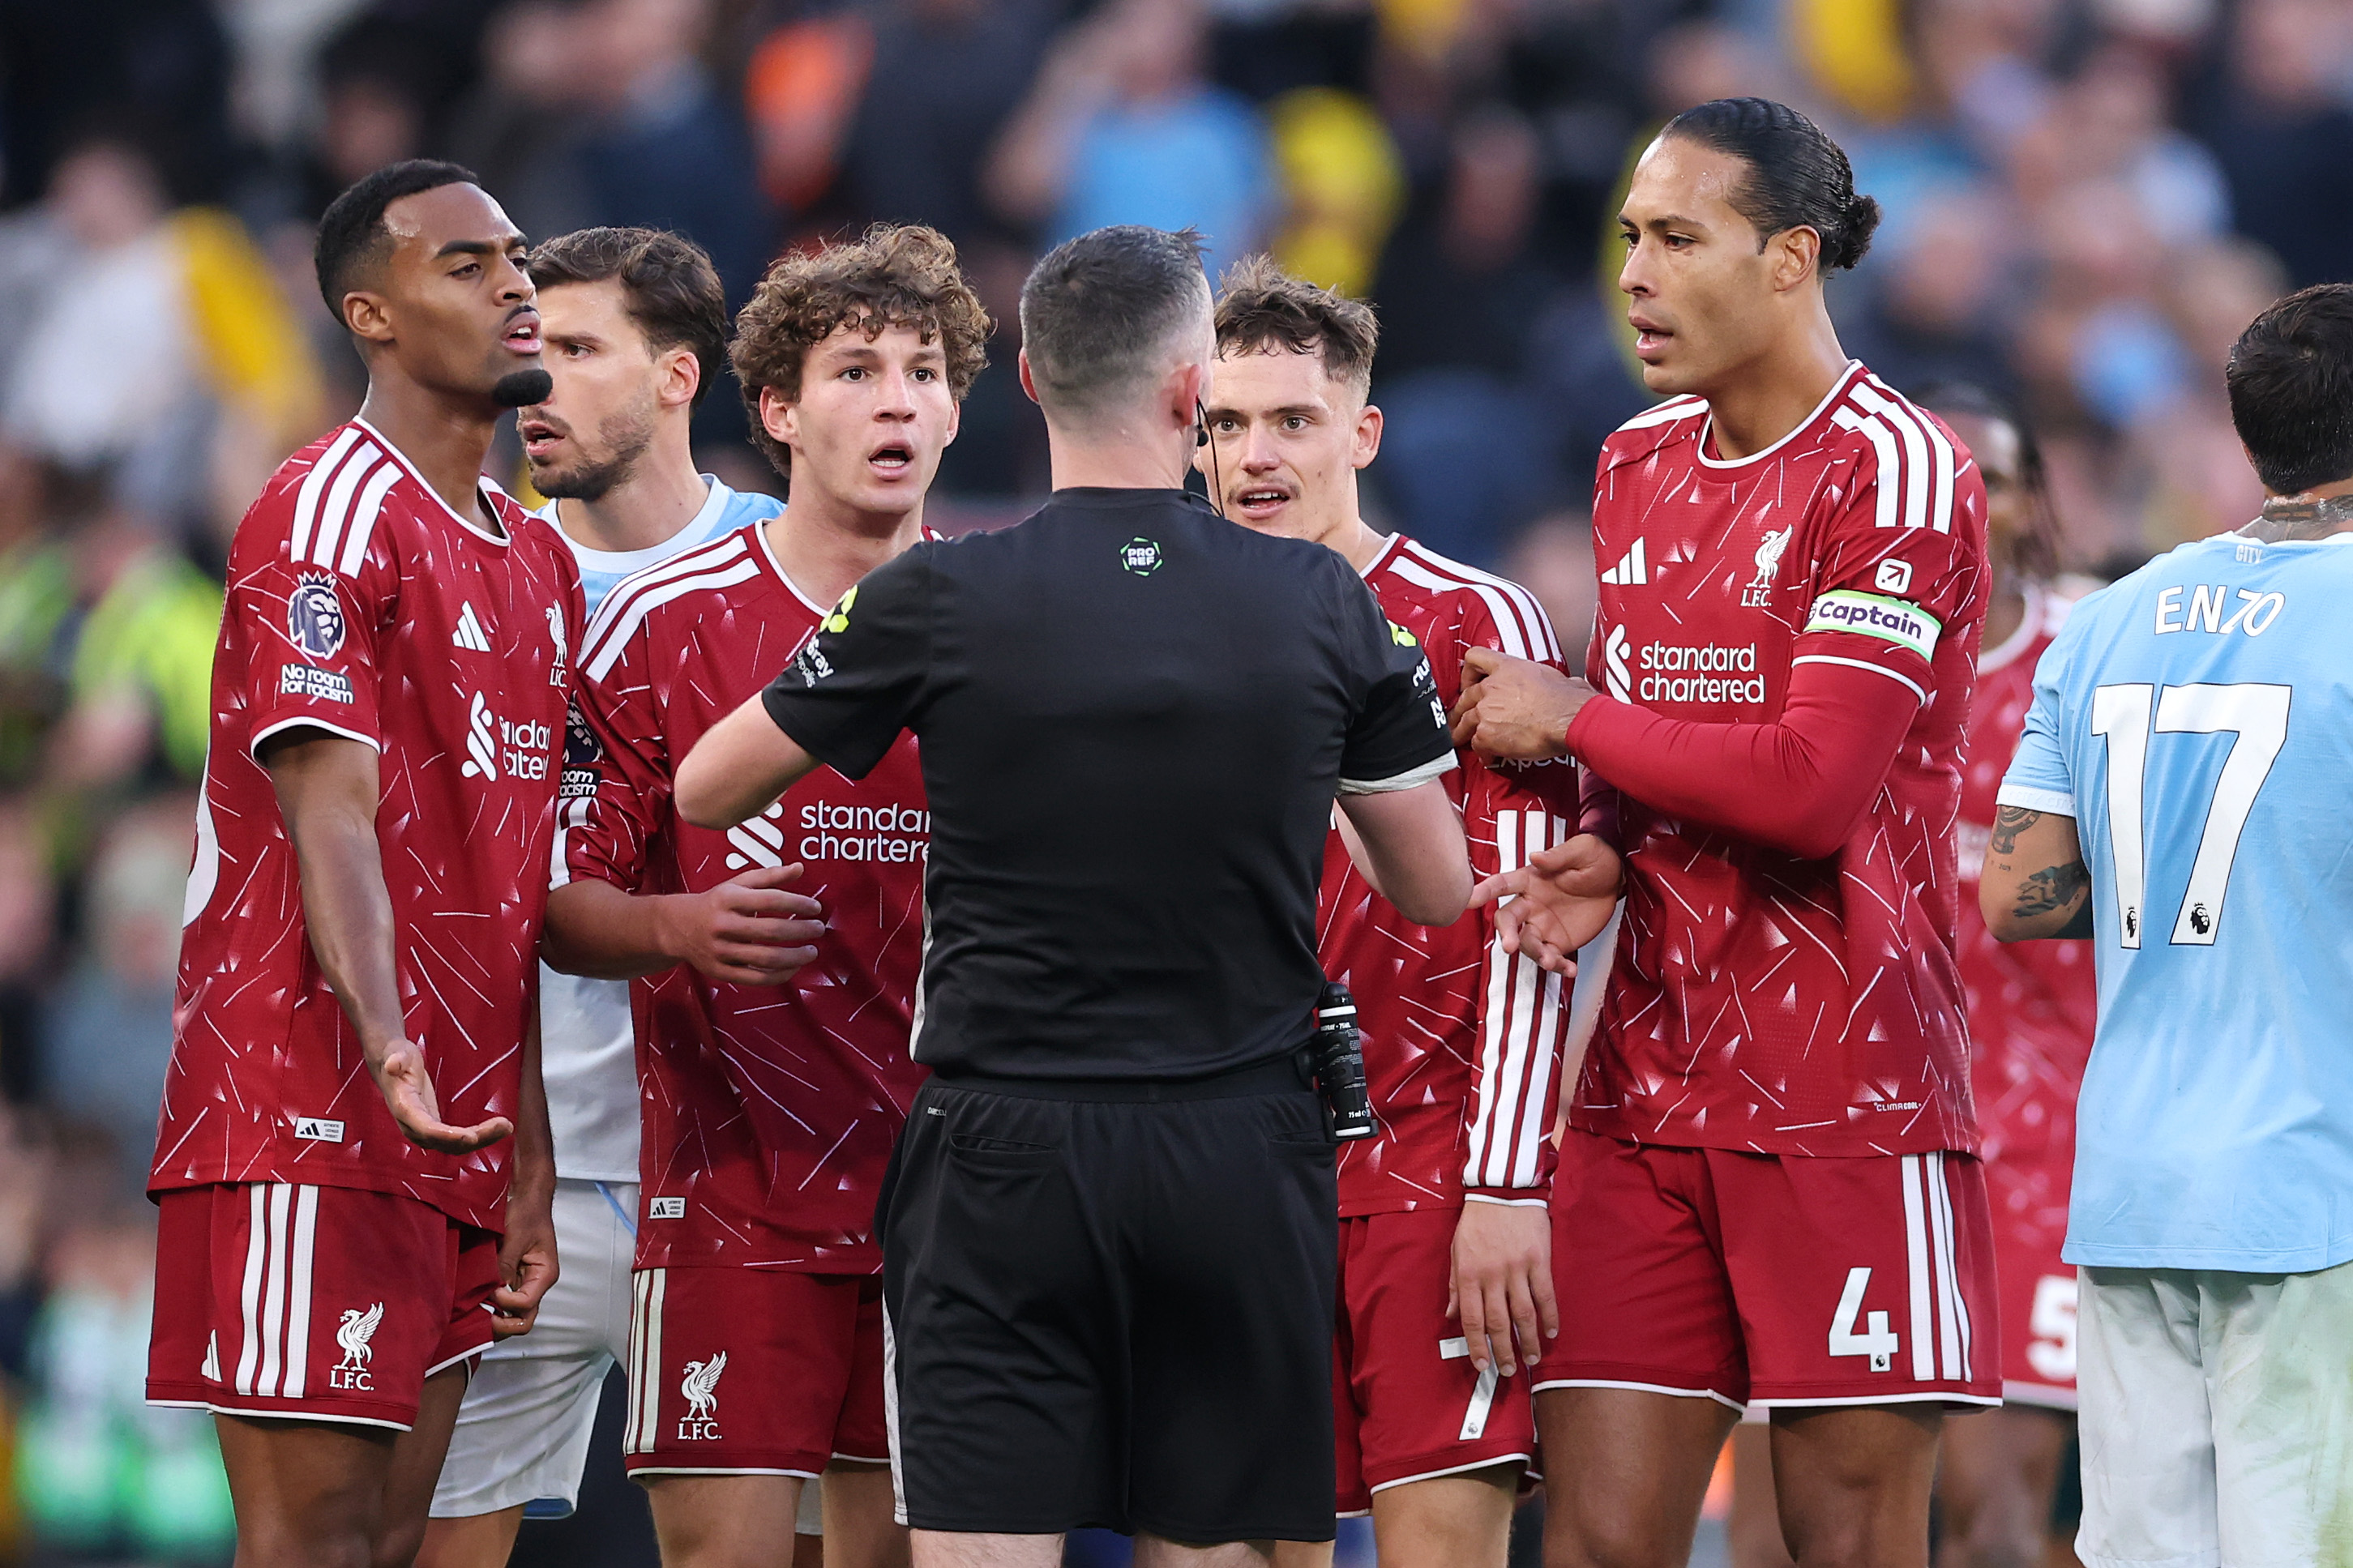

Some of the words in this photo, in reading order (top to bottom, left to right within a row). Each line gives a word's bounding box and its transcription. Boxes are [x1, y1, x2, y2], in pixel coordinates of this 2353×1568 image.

[1127, 547, 1155, 557] PRO
[1128, 557, 1155, 566] REF
[2235, 545, 2263, 564] CITY
[1740, 589, 1773, 607] L.F.C.
[1818, 600, 1922, 639] Captain
[1640, 640, 1756, 672] standard
[281, 663, 306, 679] No
[308, 669, 346, 690] room
[1640, 672, 1765, 703] chartered
[280, 677, 305, 694] for
[306, 681, 354, 705] racism
[559, 782, 597, 797] acism
[561, 770, 594, 784] oom
[800, 800, 931, 833] standar
[2091, 682, 2292, 950] 17
[800, 831, 931, 862] charter
[1828, 1267, 1898, 1373] 4
[330, 1370, 374, 1391] L.F.C.
[1440, 1334, 1499, 1441] 7
[678, 1422, 723, 1440] L.F.C.
